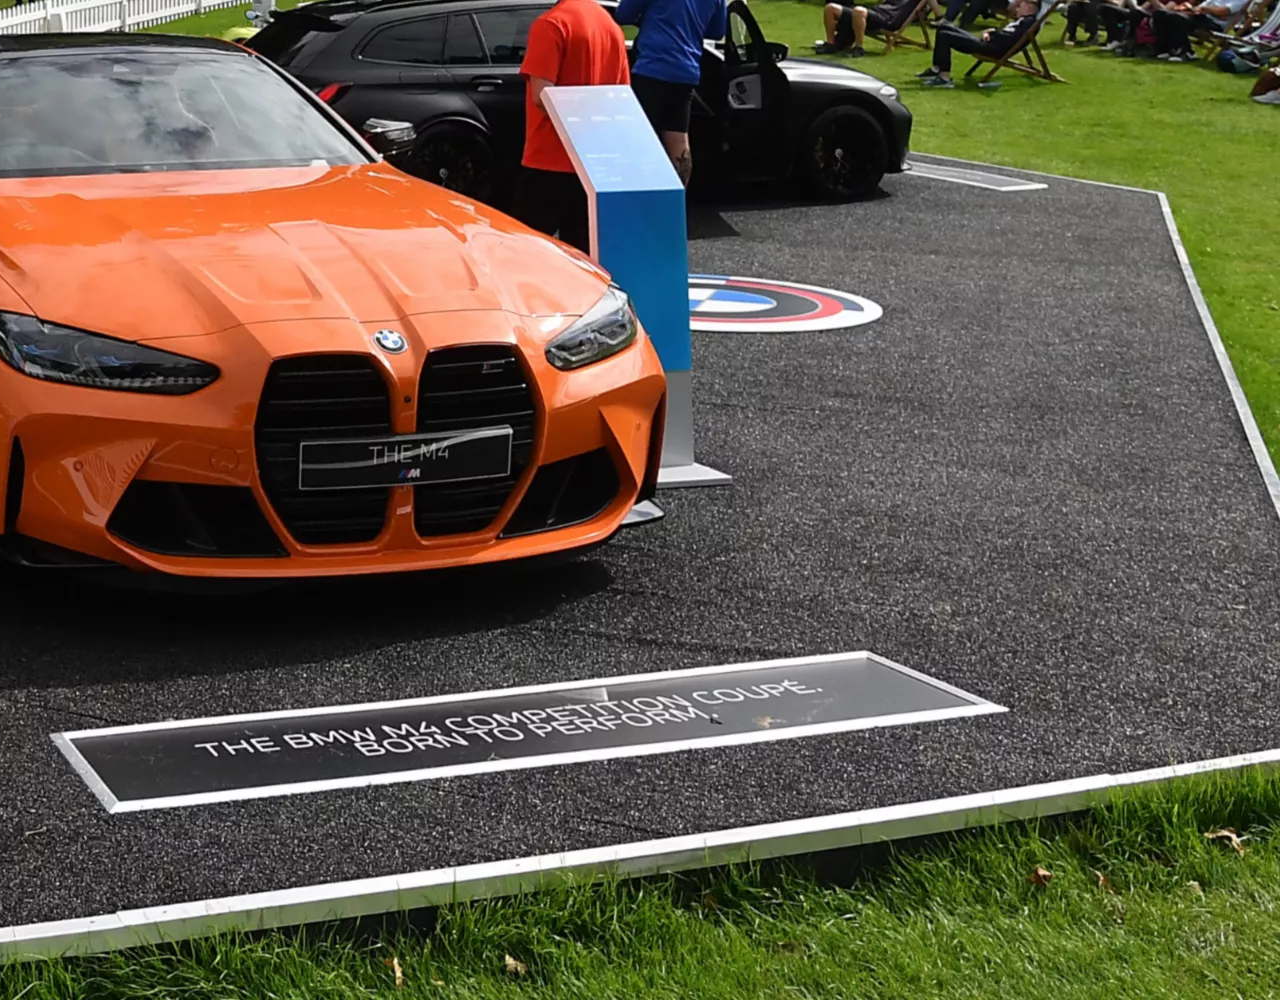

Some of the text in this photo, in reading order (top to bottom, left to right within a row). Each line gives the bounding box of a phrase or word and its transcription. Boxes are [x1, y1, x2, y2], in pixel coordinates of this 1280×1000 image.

[369, 442, 449, 465] THE M4
[194, 736, 280, 758] THE
[282, 727, 375, 749] BMW
[381, 720, 439, 738] M4
[445, 693, 692, 732] COMPETITION
[354, 706, 719, 757] BORN TO PERFORM.
